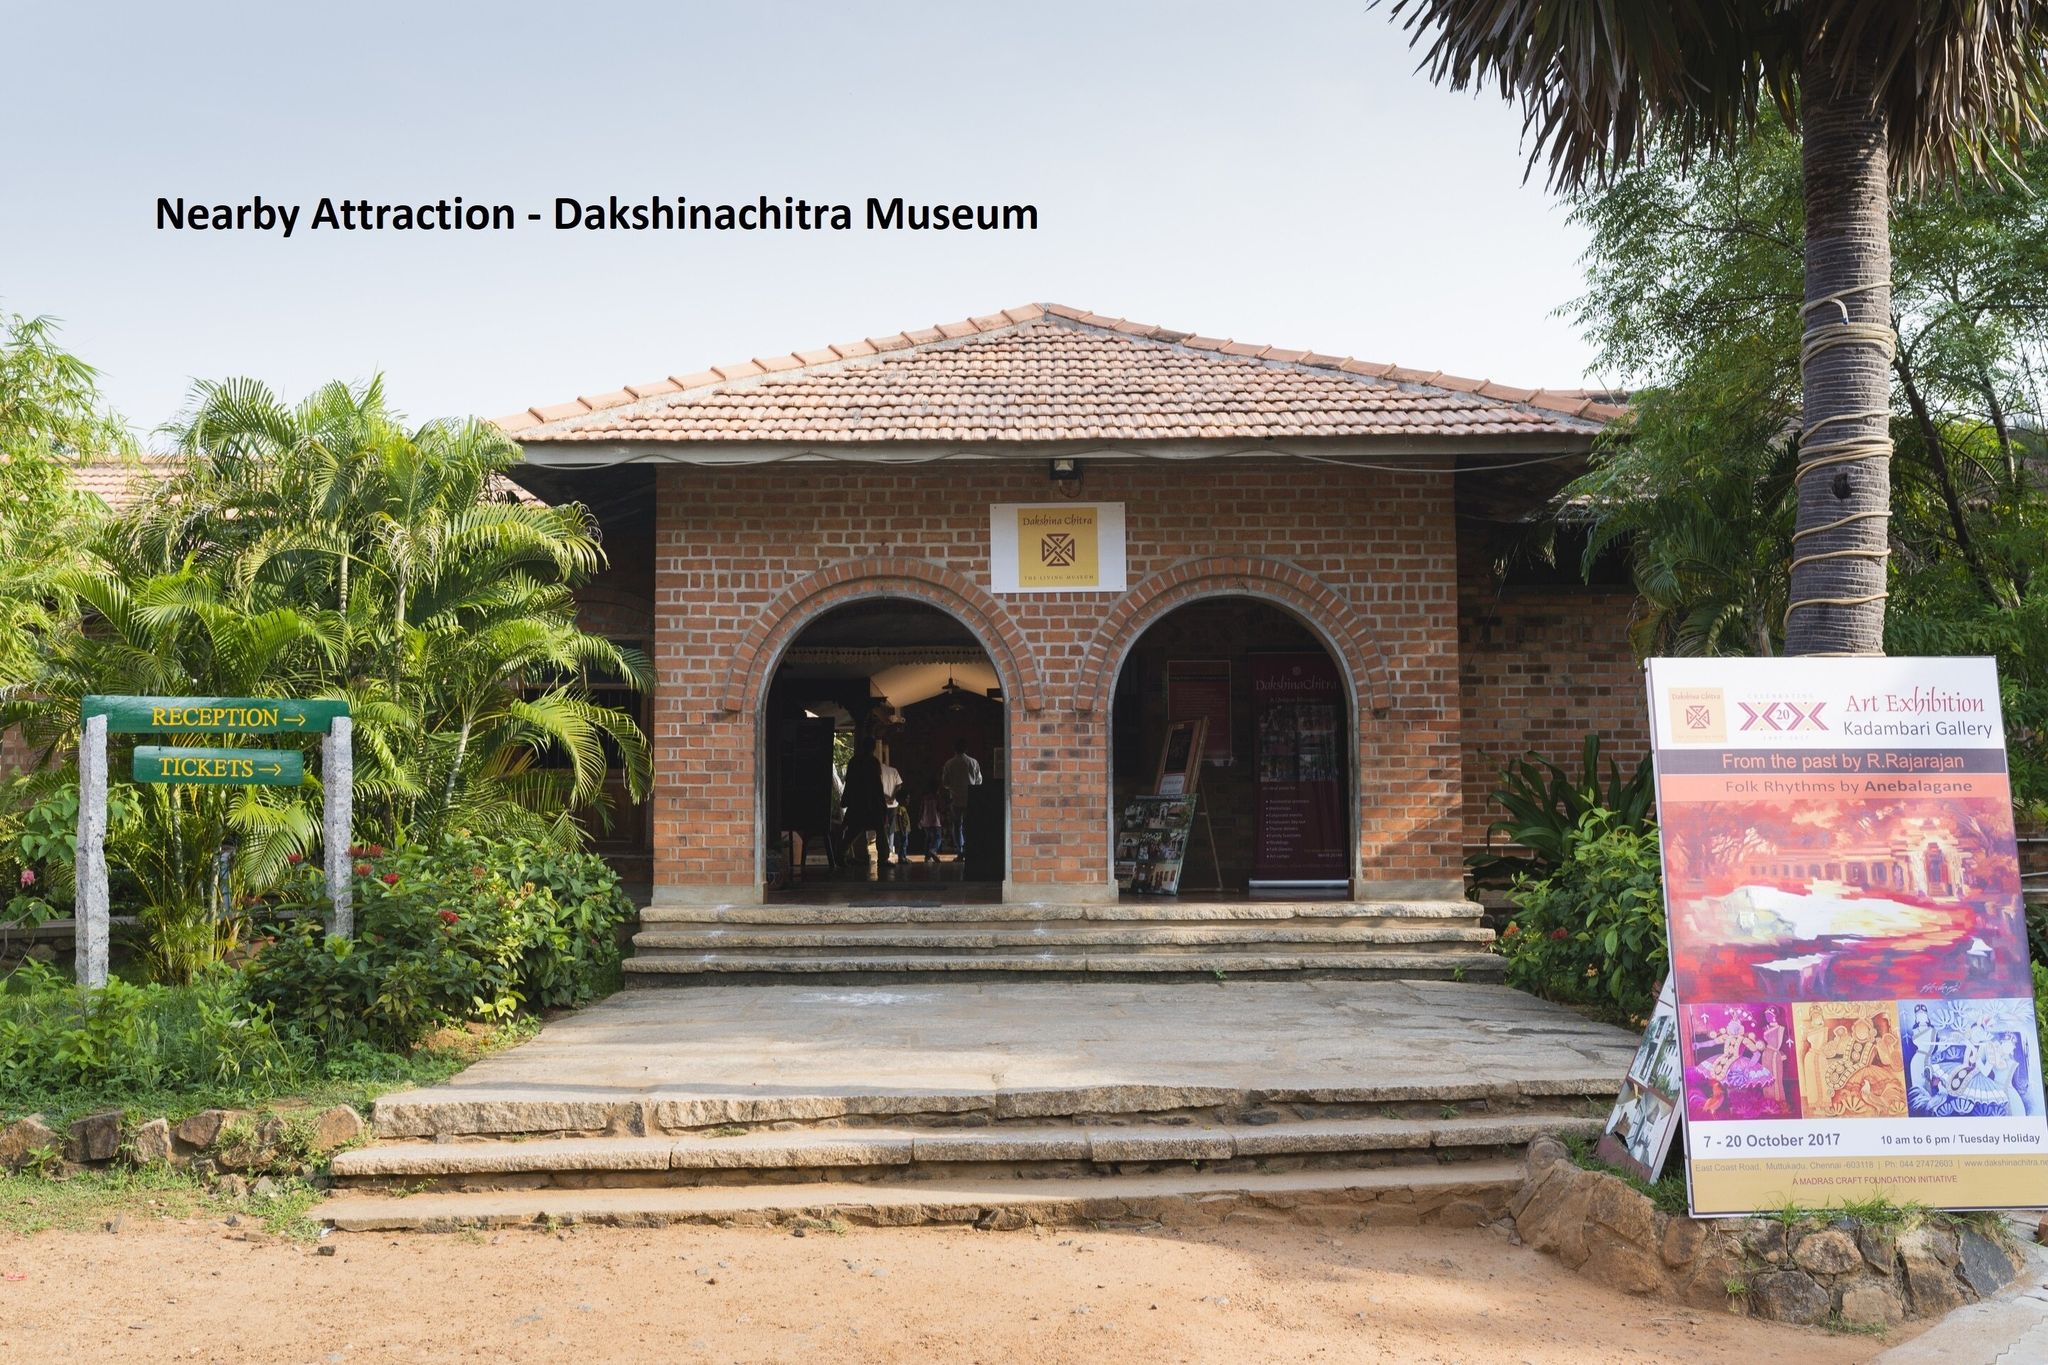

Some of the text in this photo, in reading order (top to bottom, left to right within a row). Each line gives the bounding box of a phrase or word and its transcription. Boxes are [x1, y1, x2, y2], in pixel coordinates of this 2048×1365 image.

[1023, 513, 1092, 527] Dakshina Chitra
[1845, 686, 1985, 715] Art Exhibition
[152, 705, 279, 727] RECEPTION
[1776, 709, 1790, 720] 20
[1843, 720, 1993, 739] Kadambari Gallery
[159, 757, 254, 778] TICKETS
[1722, 753, 1965, 772] From the past by R.Rajarajan
[1725, 780, 1973, 795] Folk Rhythms by Anebalagane
[1703, 1135, 1712, 1149] 7
[1726, 1135, 1742, 1148] 20
[1746, 1133, 1804, 1147] October
[1808, 1133, 1841, 1147] 2017
[1881, 1135, 1892, 1145] 10
[1895, 1136, 1911, 1145] am
[1913, 1135, 1923, 1144] to
[1925, 1135, 1932, 1144] 6
[1934, 1136, 1951, 1147] pm
[1958, 1134, 2000, 1146] Tuesday
[2002, 1133, 2041, 1145] Holiday
[1695, 1164, 1712, 1172] East
[1714, 1163, 1737, 1172] Coast
[1809, 1161, 1841, 1170] Chennai
[1792, 1174, 1958, 1185] A MADRAS CRAFT FOUNDATION INITIATIVE
